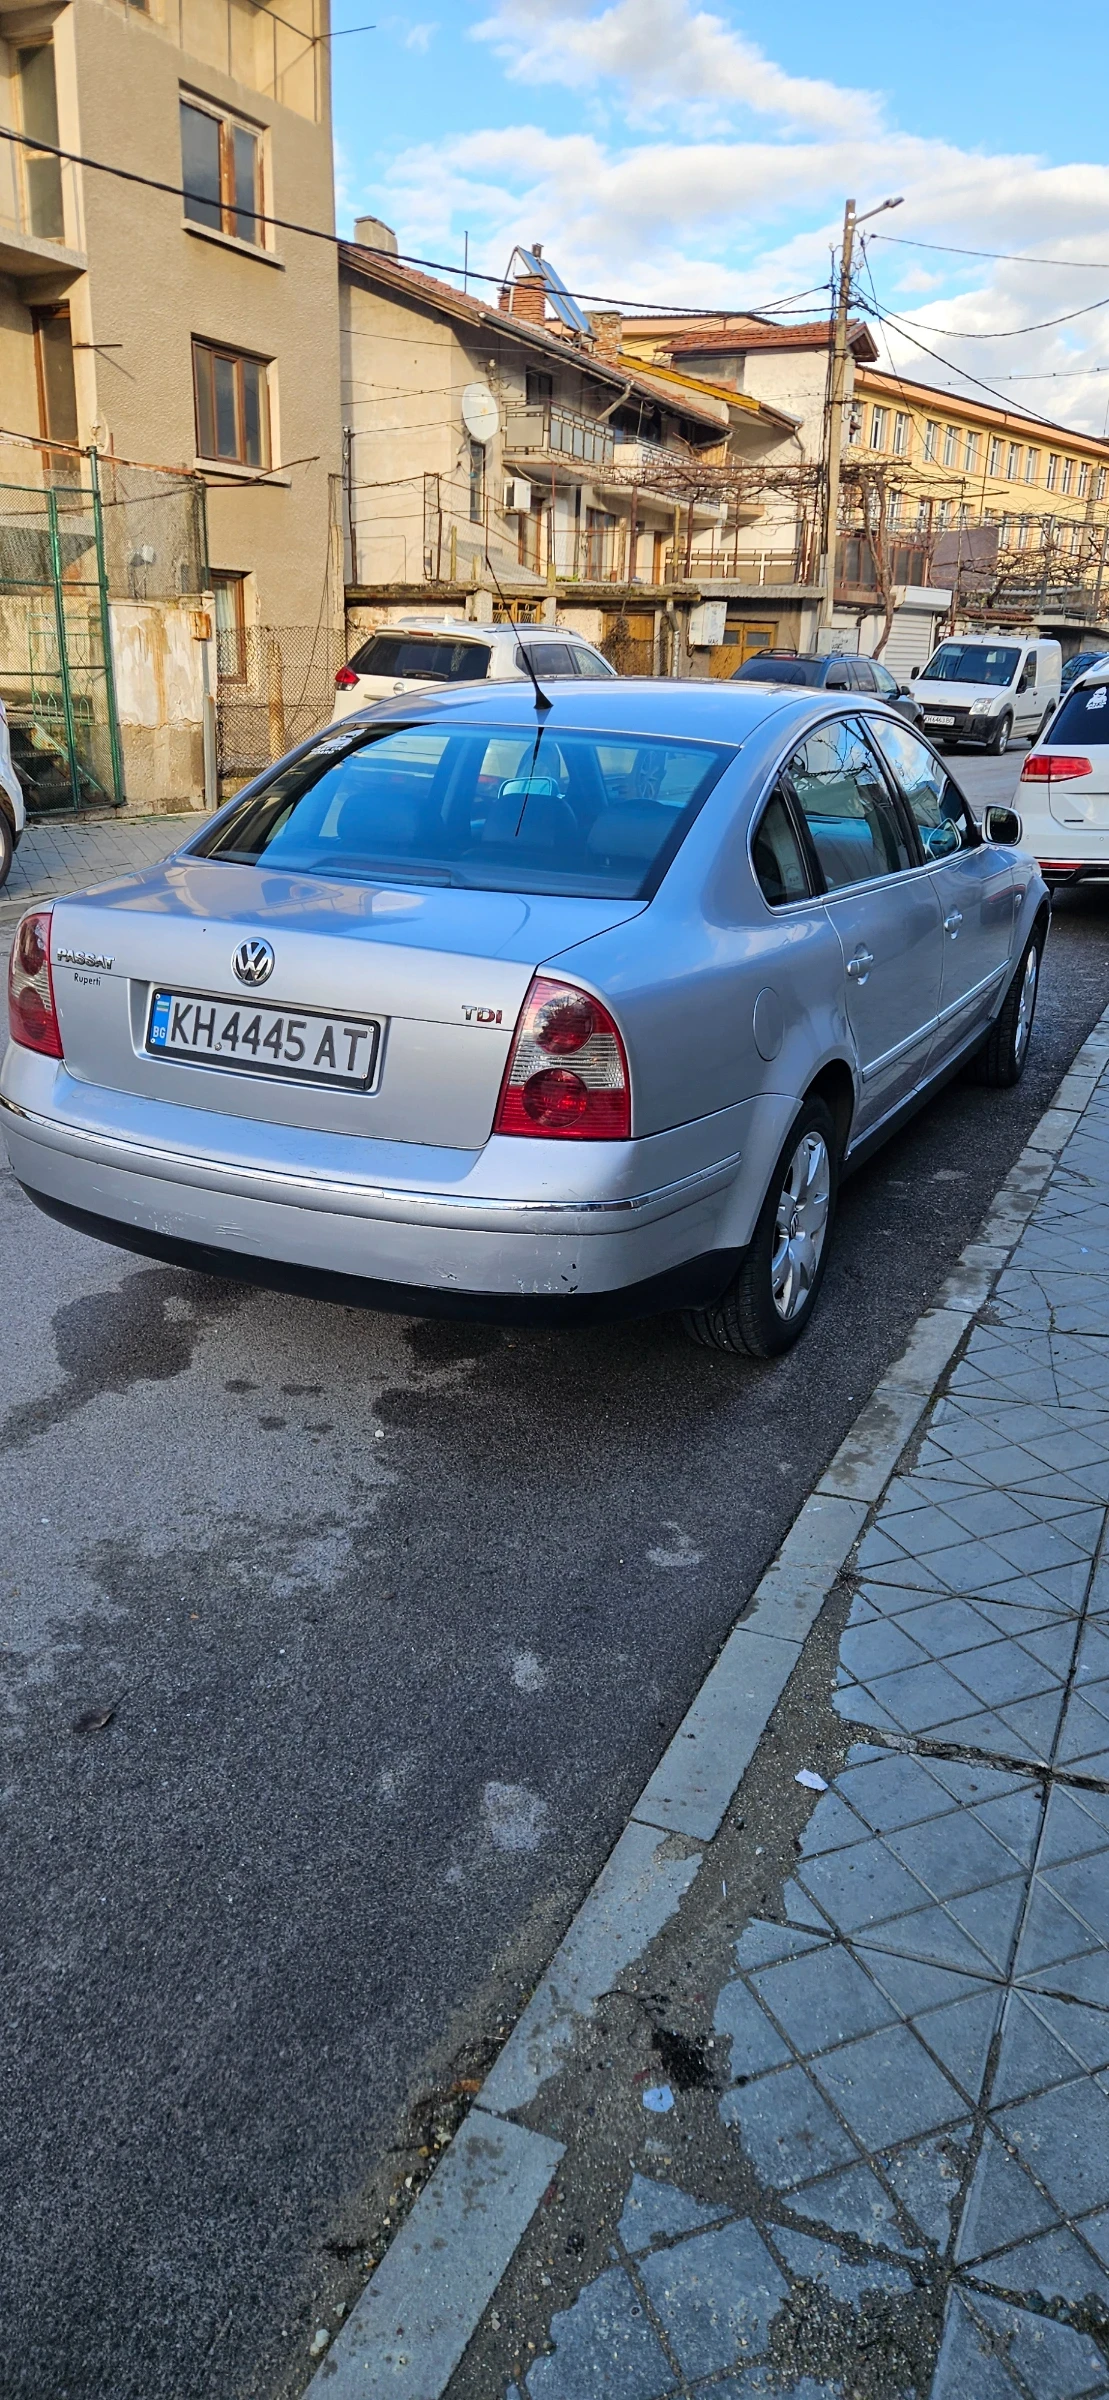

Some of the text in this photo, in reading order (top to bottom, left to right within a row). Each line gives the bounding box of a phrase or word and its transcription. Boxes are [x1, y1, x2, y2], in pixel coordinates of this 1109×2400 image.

[57, 947, 116, 970] PASSAT
[74, 972, 101, 986] Ruperti
[461, 1004, 503, 1025] TDI
[152, 1002, 368, 1071] BG KH 4445 AT
